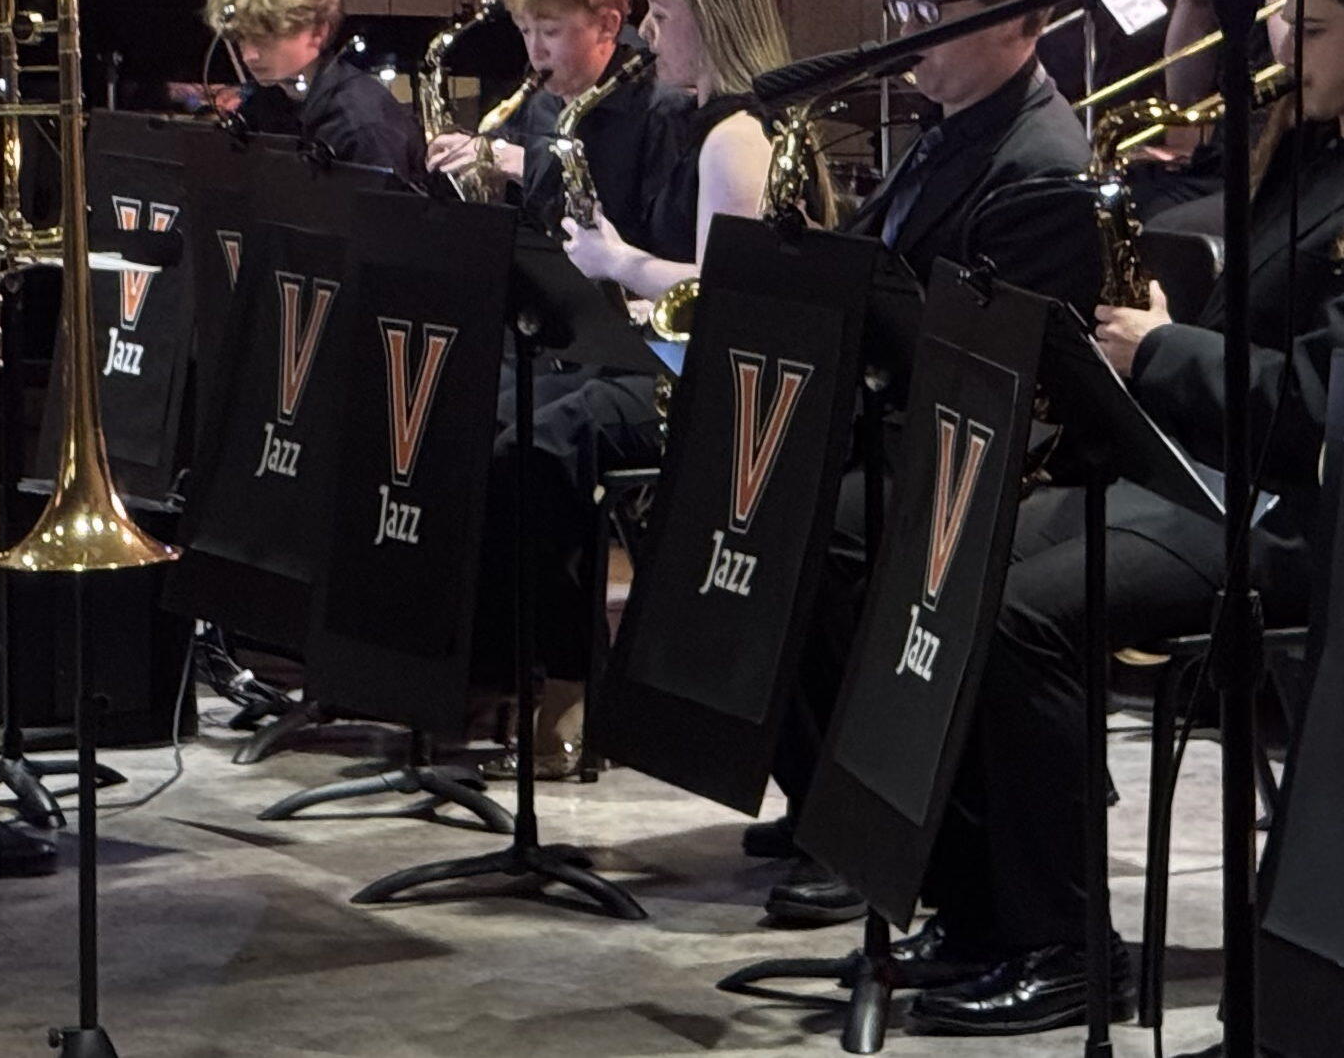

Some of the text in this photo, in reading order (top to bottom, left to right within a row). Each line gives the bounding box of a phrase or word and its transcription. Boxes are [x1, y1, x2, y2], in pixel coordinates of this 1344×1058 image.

[103, 327, 144, 376] Jazz
[275, 270, 341, 425] V
[377, 316, 459, 486] V
[255, 422, 302, 477] Jazz
[729, 348, 815, 534] V
[374, 484, 422, 545] Jazz
[922, 402, 995, 612] V
[699, 529, 757, 596] Jazz
[895, 604, 940, 682] Jazz
